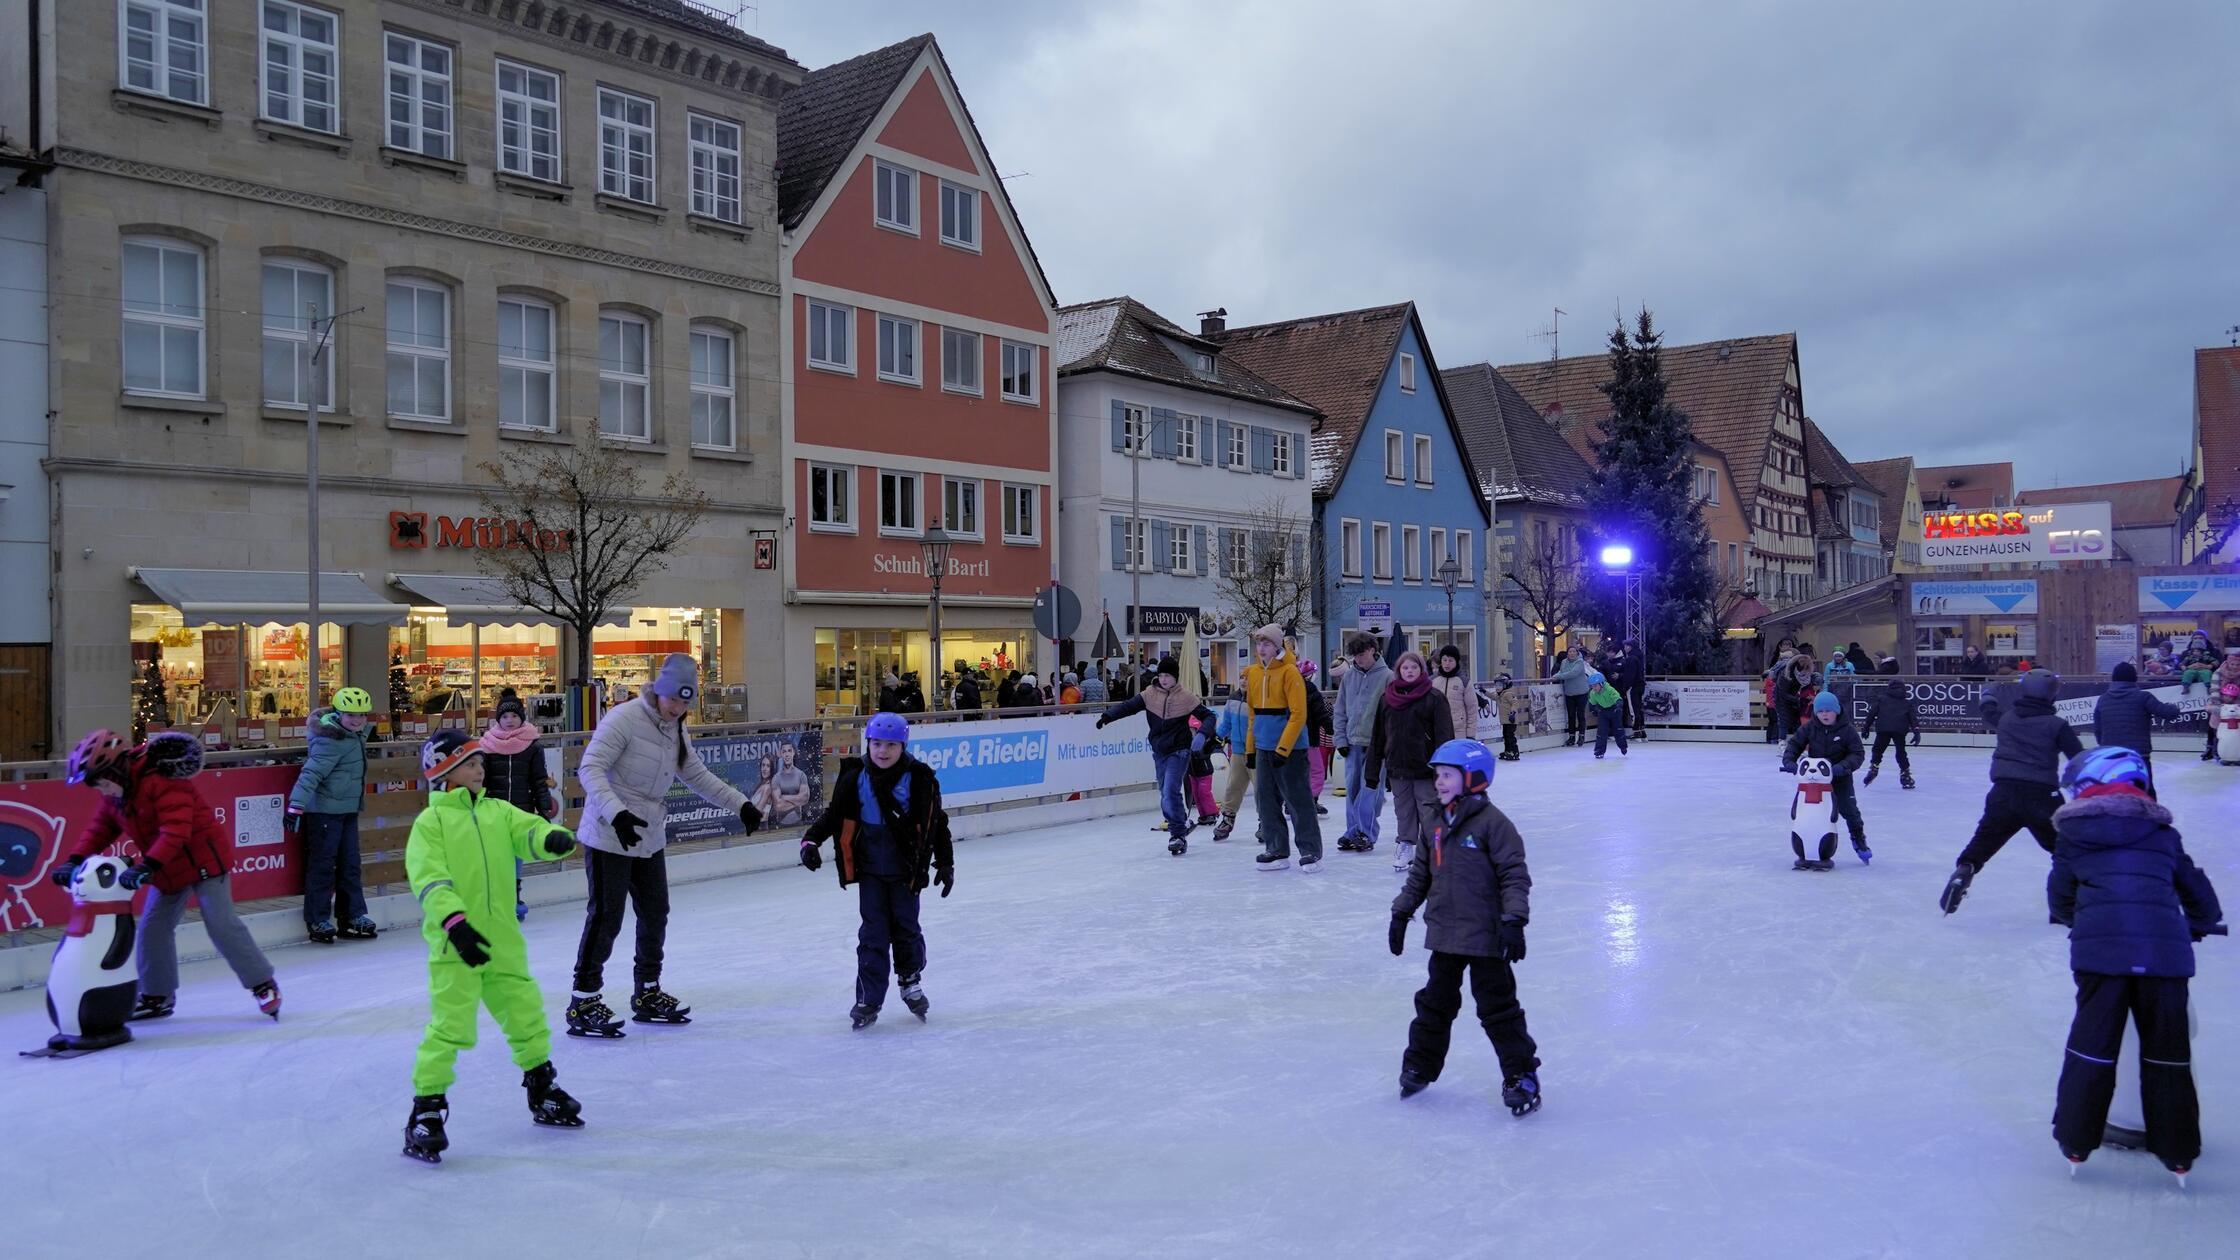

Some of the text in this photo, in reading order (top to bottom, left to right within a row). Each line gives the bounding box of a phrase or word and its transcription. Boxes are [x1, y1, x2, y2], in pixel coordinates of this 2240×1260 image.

[436, 515, 577, 552] Müller
[1924, 510, 2054, 540] HEISS auf
[1926, 541, 2032, 558] GUNZENHAUSEN
[2048, 529, 2105, 554] EIS
[873, 553, 921, 574] Schuh
[948, 558, 990, 577] Bartl
[1914, 581, 2036, 596] Schlittschuhverleih
[2153, 578, 2199, 590] Kasse
[1917, 704, 1967, 715] GRUPPE
[2057, 700, 2092, 712] AUFEN
[695, 740, 782, 764] STE VERSION
[910, 734, 1046, 769] ber & Riedel
[1058, 743, 1077, 761] Mit
[1079, 744, 1099, 758] uns
[1101, 740, 1126, 756] baut
[1127, 738, 1144, 753] die
